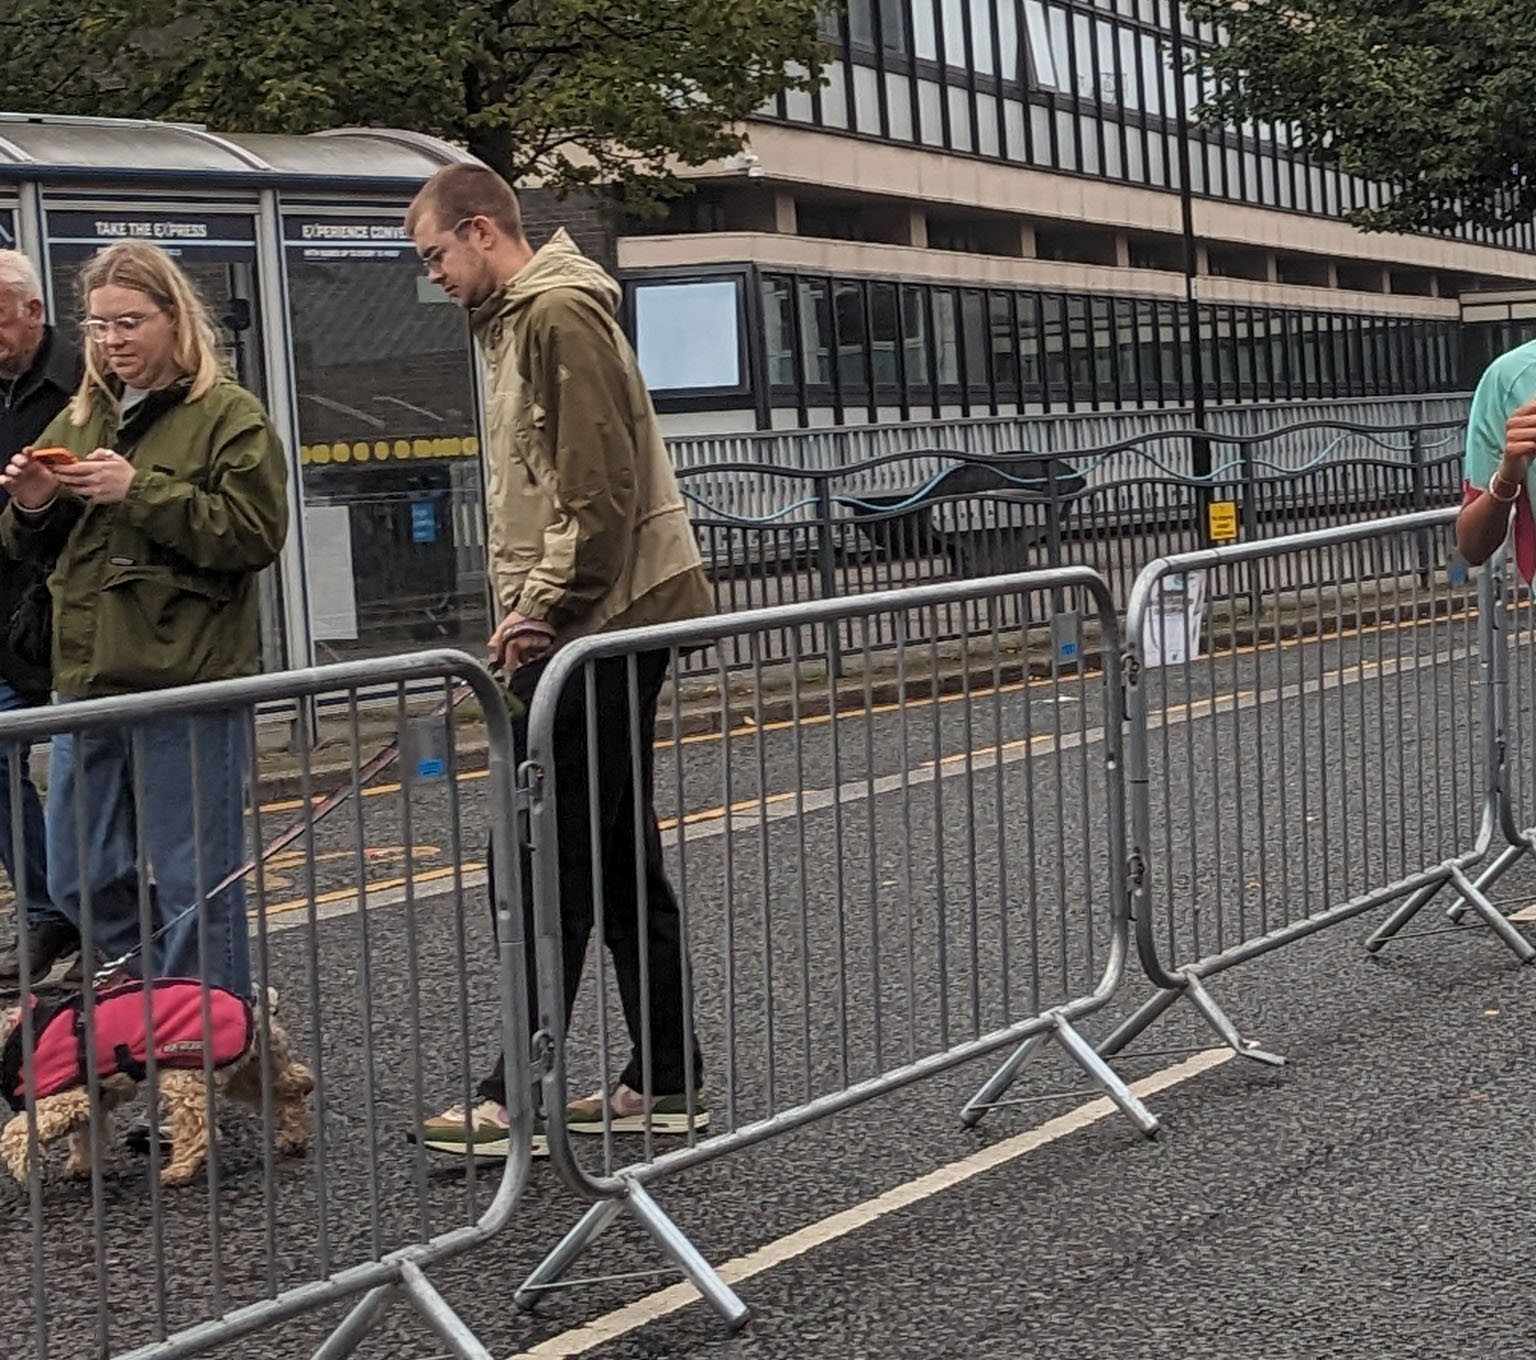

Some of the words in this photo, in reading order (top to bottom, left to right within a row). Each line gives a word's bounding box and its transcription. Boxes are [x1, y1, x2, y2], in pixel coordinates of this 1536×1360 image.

[95, 221, 127, 236] TAKE
[129, 222, 153, 236] THE
[154, 222, 207, 237] EXPRESS
